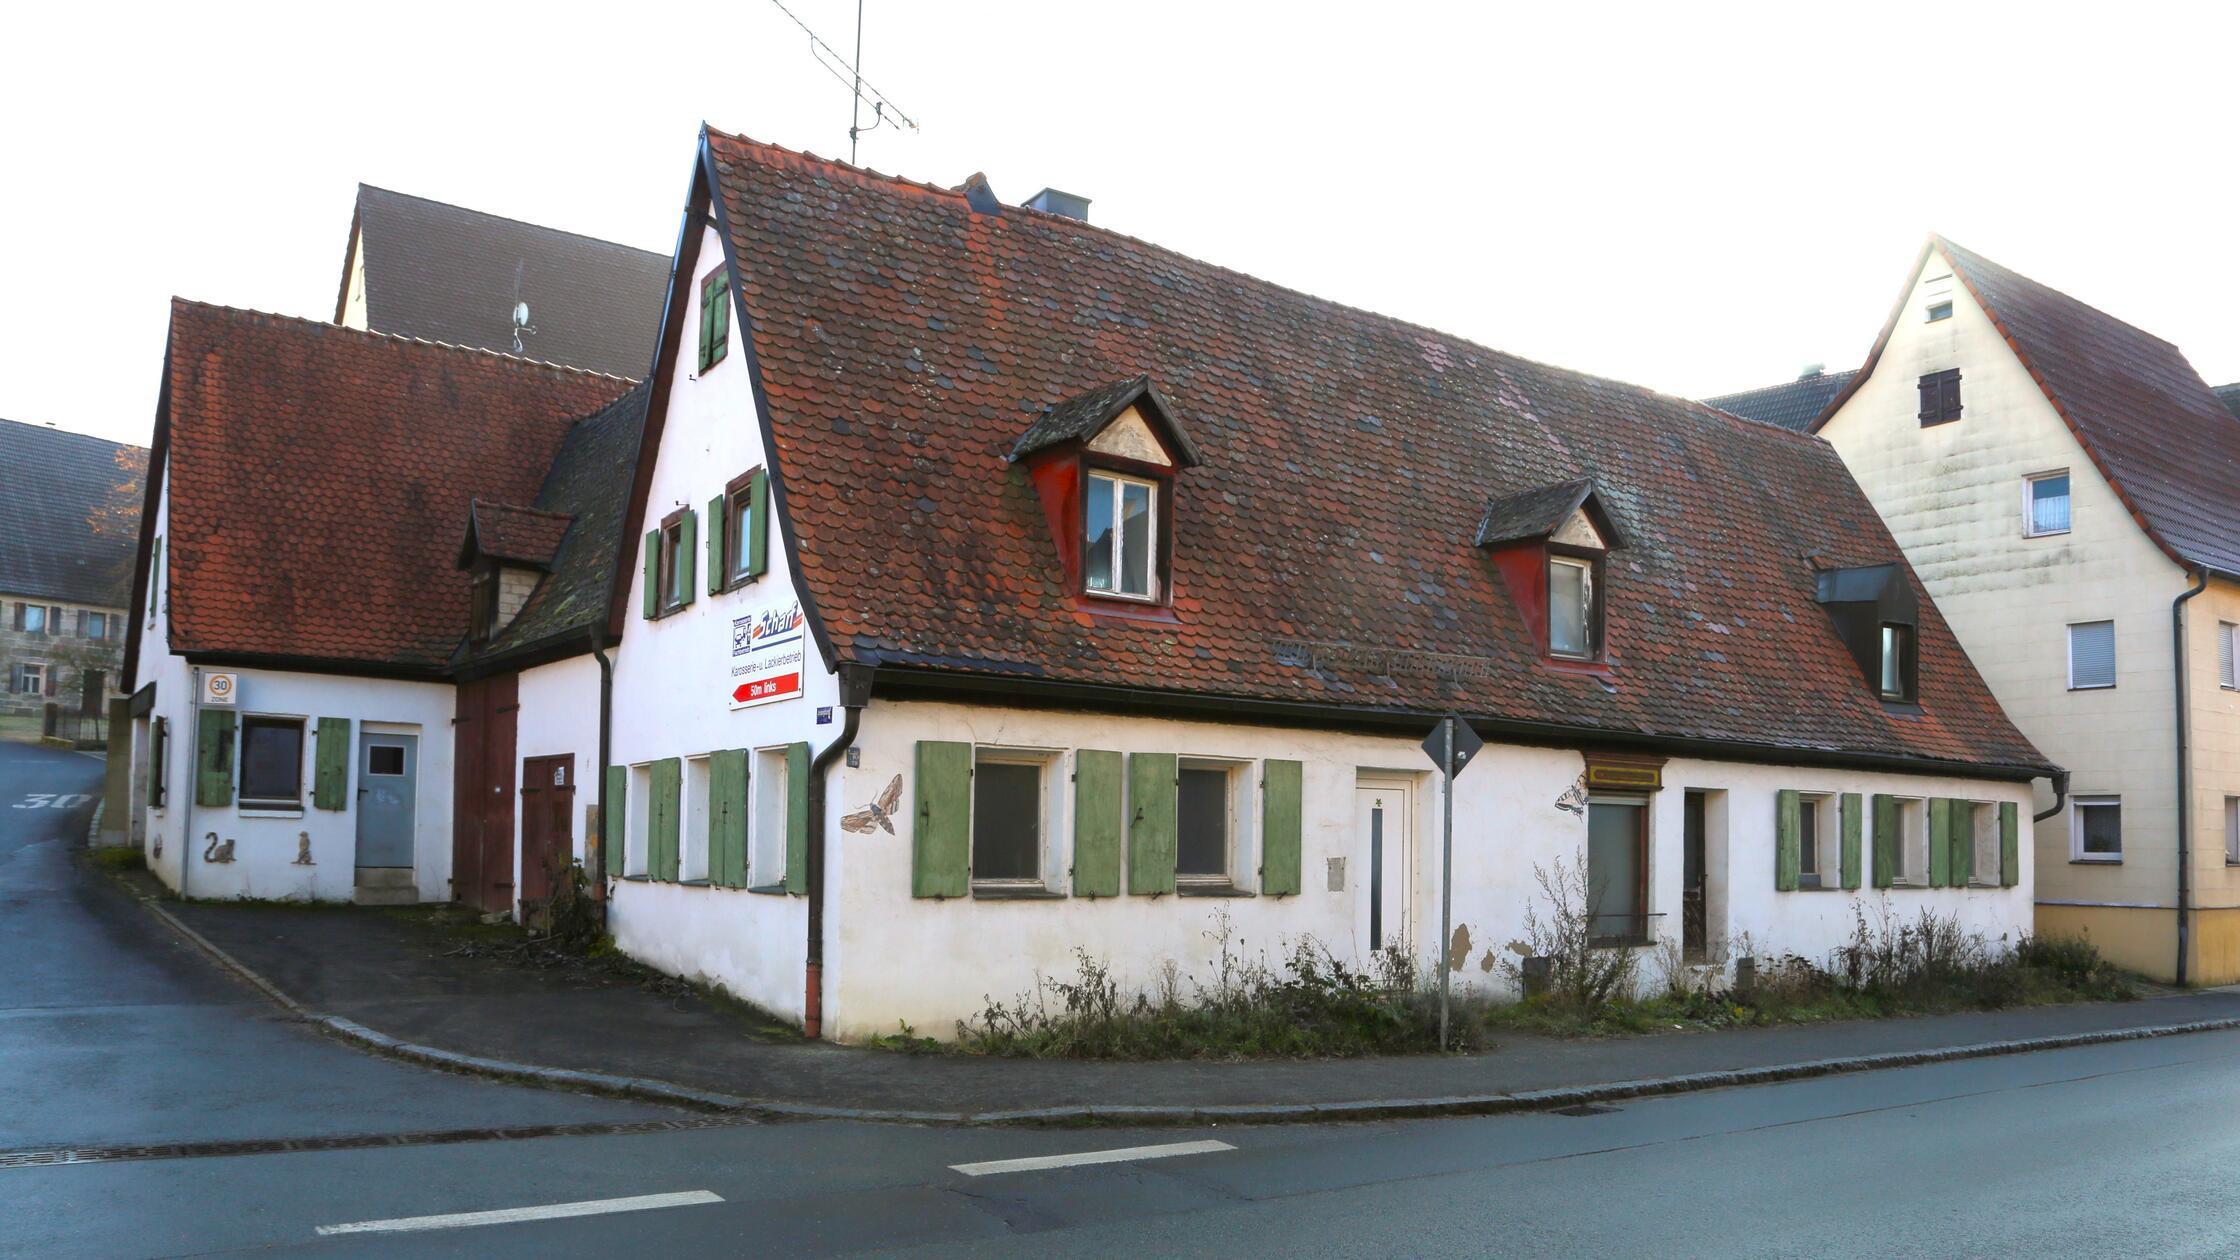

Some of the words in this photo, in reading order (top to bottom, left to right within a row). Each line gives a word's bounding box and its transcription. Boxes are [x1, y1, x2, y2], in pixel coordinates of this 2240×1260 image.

[214, 680, 228, 690] 30
[750, 684, 763, 697] 50m
[763, 681, 777, 694] links
[12, 793, 93, 809] 30
